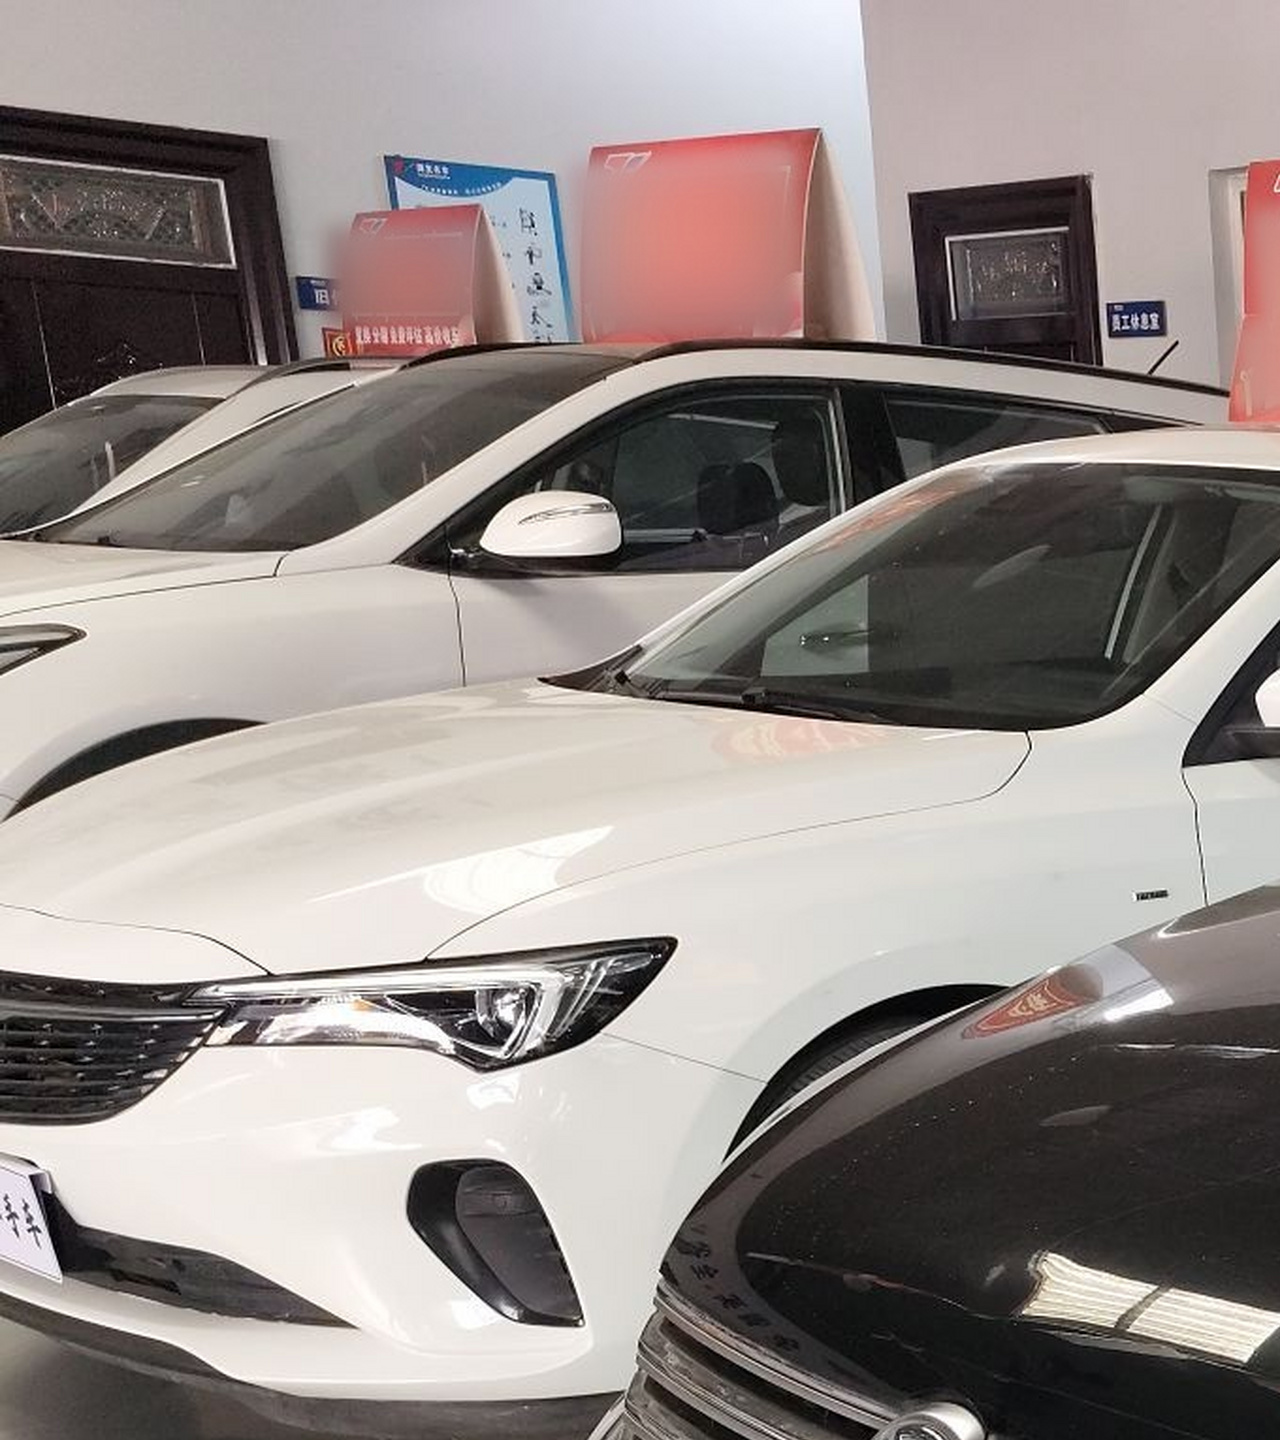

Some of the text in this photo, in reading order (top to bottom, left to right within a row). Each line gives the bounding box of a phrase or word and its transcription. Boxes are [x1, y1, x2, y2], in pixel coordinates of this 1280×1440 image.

[1112, 312, 1160, 332] 员工休息室
[0, 1192, 43, 1250] 手车
